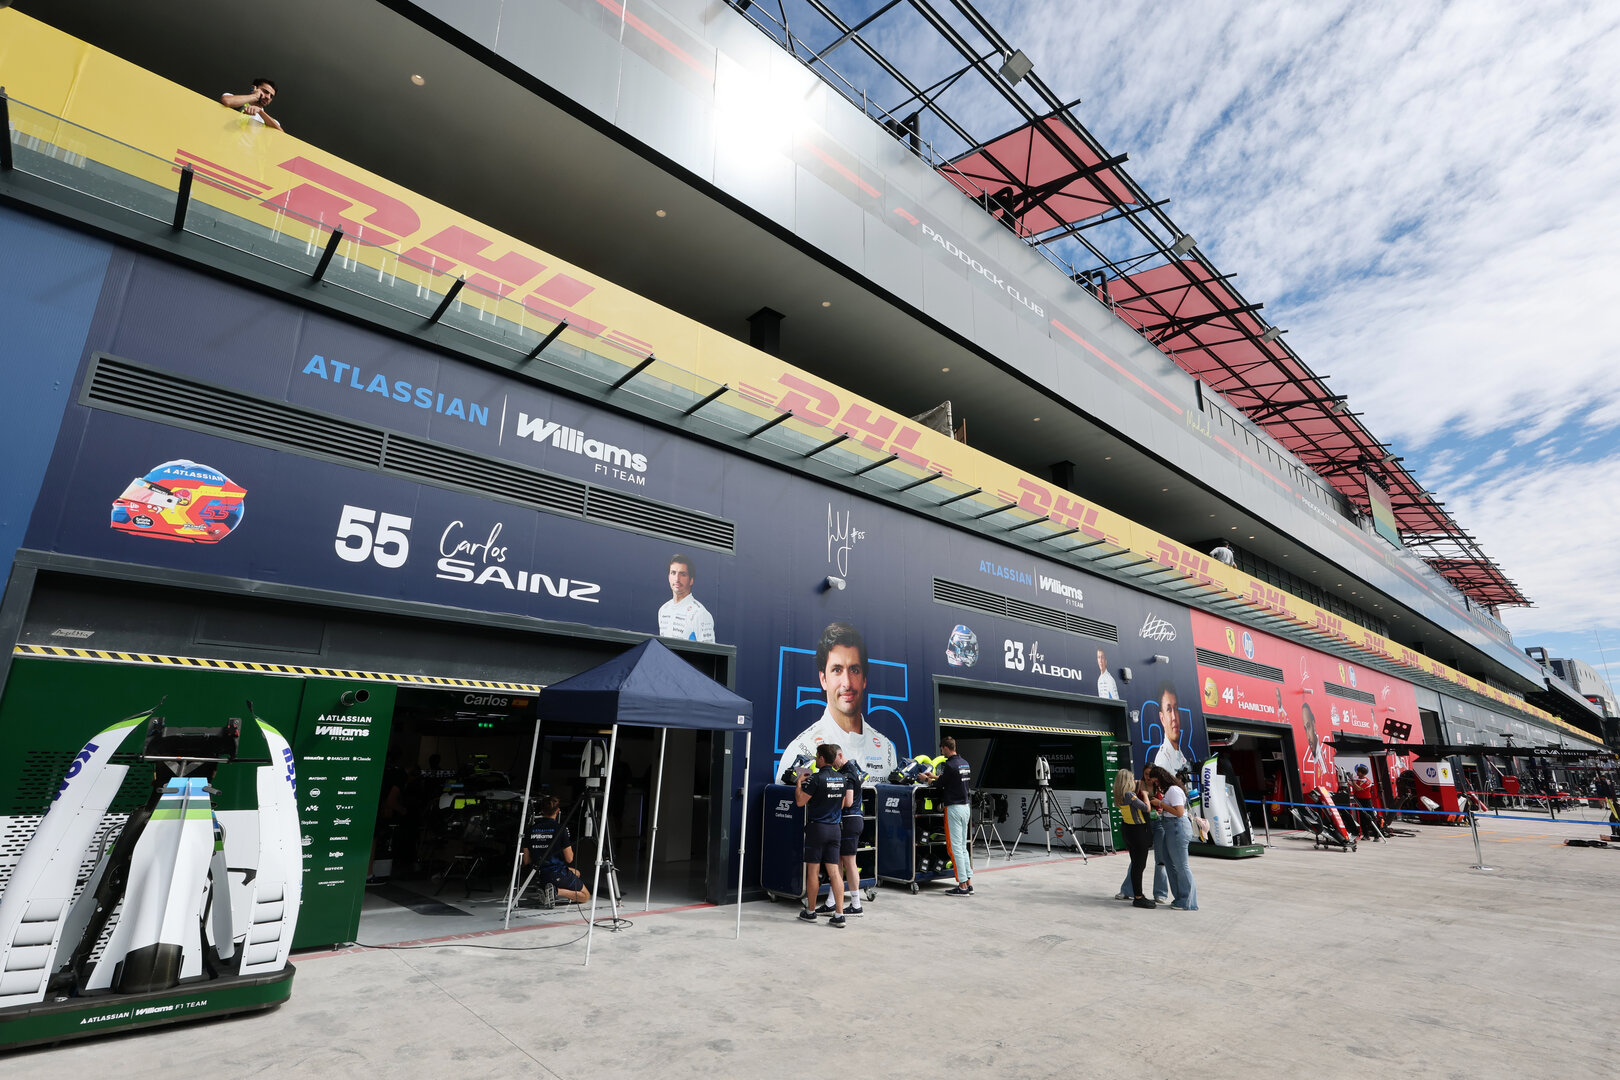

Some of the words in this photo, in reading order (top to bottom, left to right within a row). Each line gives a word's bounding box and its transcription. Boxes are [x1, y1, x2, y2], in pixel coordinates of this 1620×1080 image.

[259, 156, 608, 339] DHL
[922, 224, 1004, 290] PADDOCK
[1007, 286, 1045, 317] CLUB
[302, 354, 489, 426] ATLASSIAN
[774, 373, 930, 470] DHL
[516, 412, 648, 473] Williams
[173, 469, 224, 481] ATLASSIAN
[594, 463, 608, 476] F1
[612, 468, 646, 486] TEAM
[1017, 478, 1105, 540] DHL
[335, 504, 412, 569] 55
[440, 521, 508, 563] Carlos
[979, 560, 1033, 586] ATLASSIAN
[1157, 539, 1215, 585] DHL
[436, 557, 601, 603] SAINZ
[1039, 575, 1083, 600] Williams
[1250, 581, 1290, 617] DHL
[1314, 610, 1346, 639] DHL
[1004, 639, 1025, 671] 23
[1028, 640, 1045, 664] Alex
[1031, 662, 1082, 680] ALBON
[464, 694, 508, 707] Carlos
[1222, 687, 1234, 704] 44
[1238, 701, 1275, 714] HAMILTON
[315, 725, 370, 737] Williams
[326, 714, 372, 723] ATLASSIAN
[775, 800, 794, 811] 55
[885, 797, 900, 807] 23
[86, 1011, 130, 1024] ATLASSIAN
[135, 1005, 174, 1016] Williams
[186, 1000, 208, 1008] TEAM
